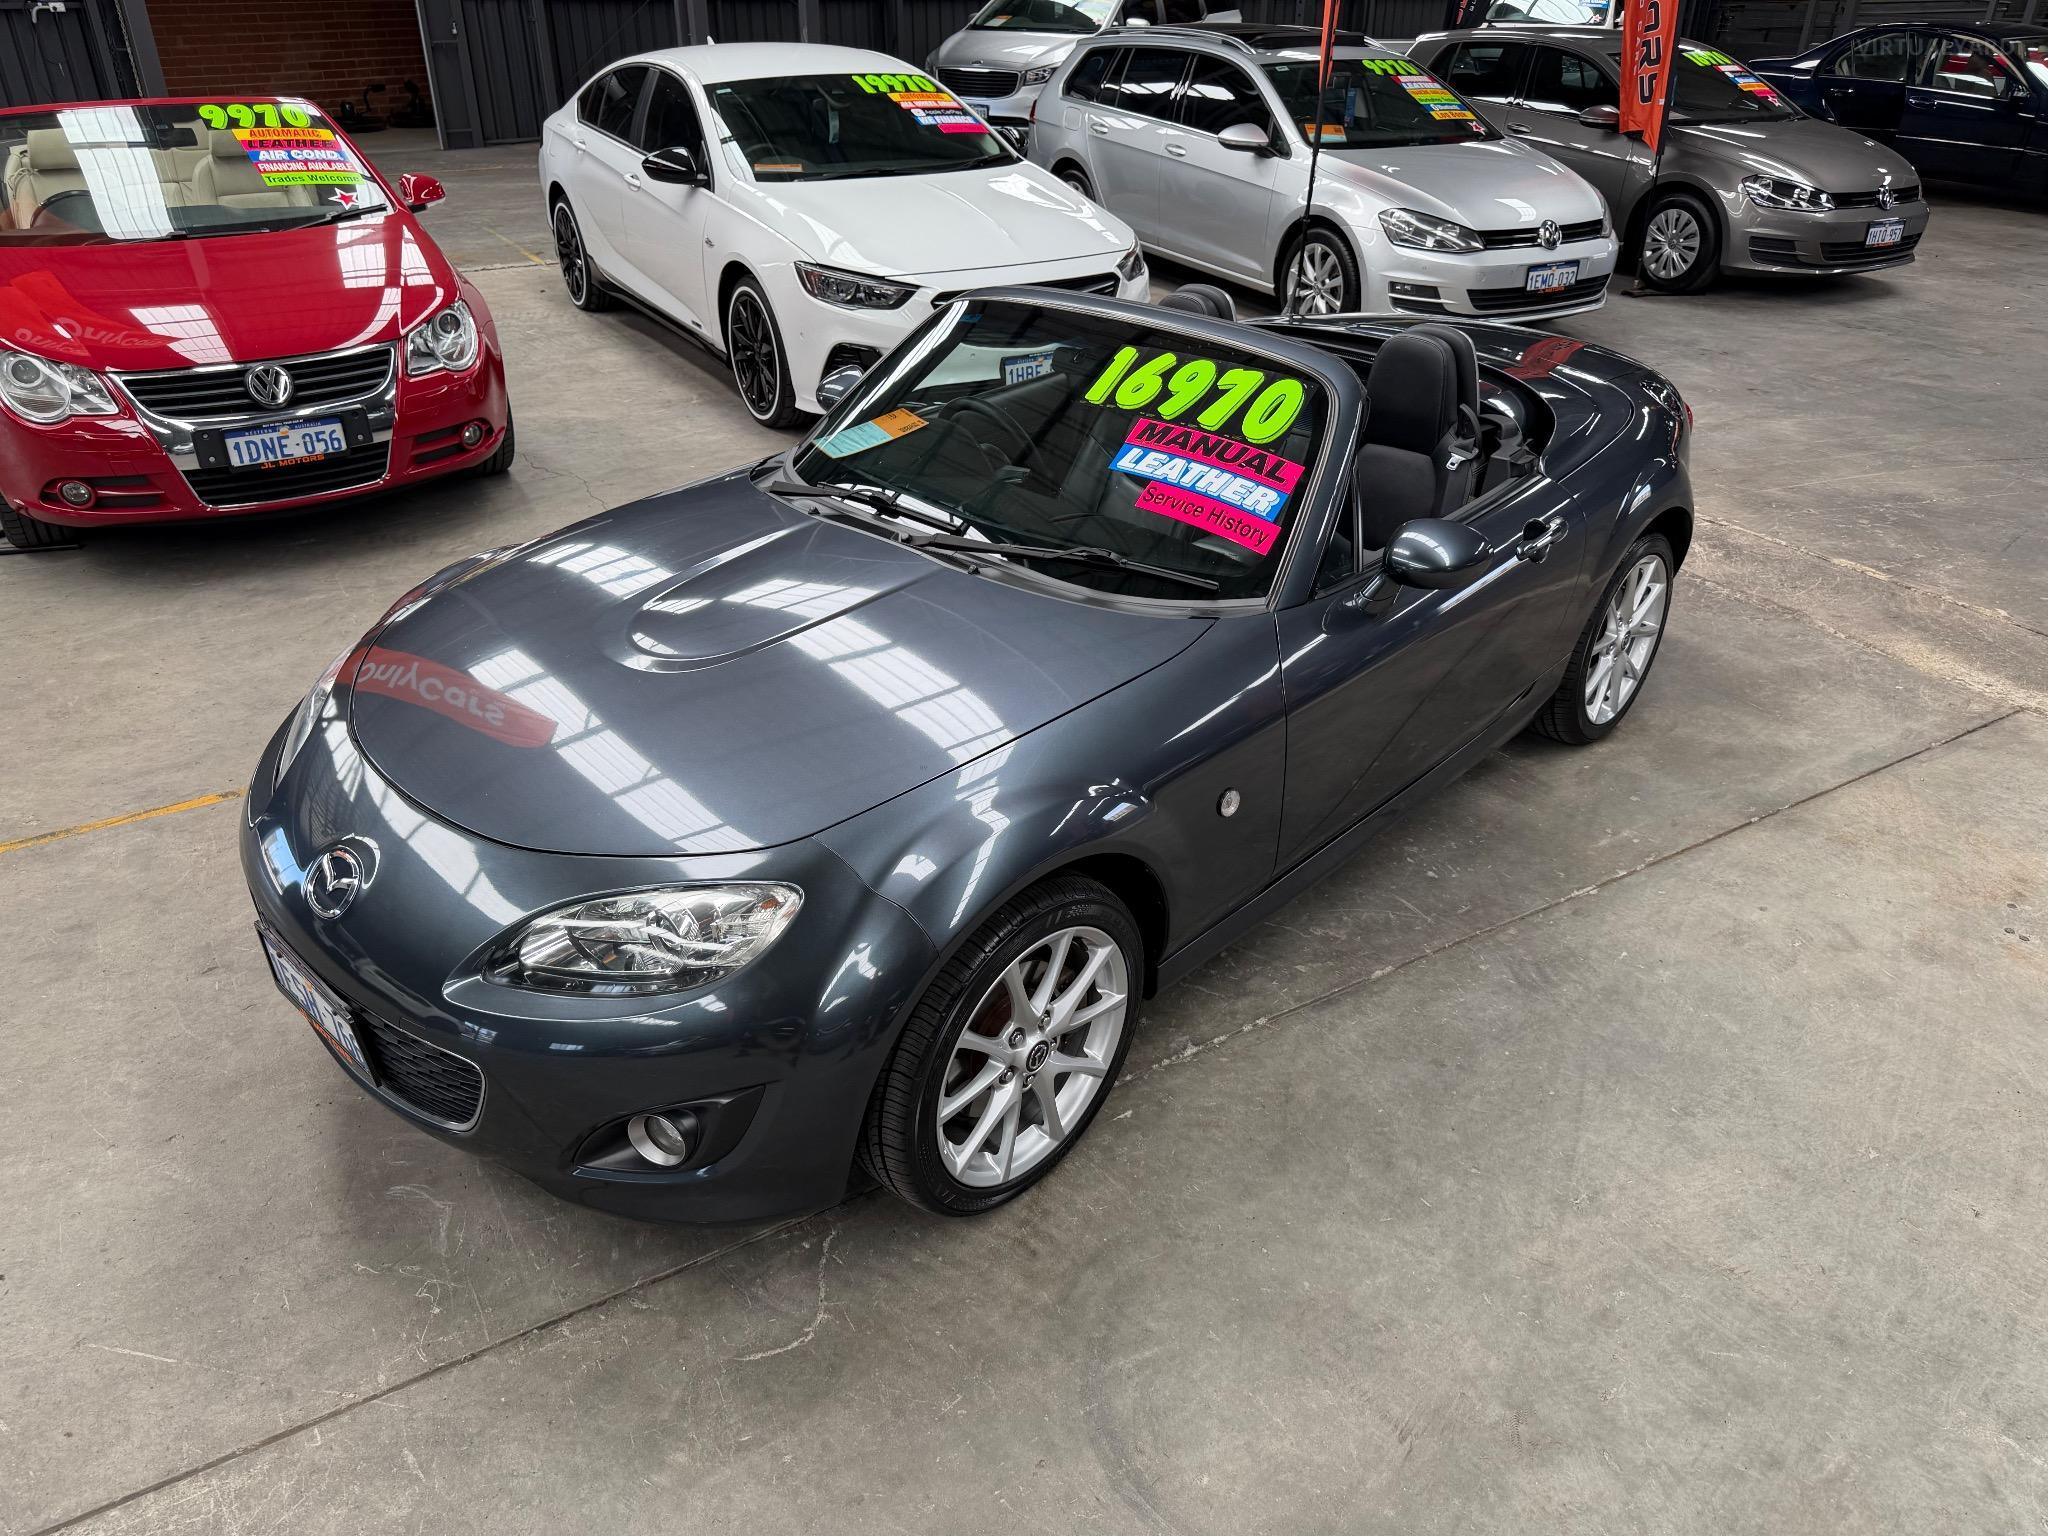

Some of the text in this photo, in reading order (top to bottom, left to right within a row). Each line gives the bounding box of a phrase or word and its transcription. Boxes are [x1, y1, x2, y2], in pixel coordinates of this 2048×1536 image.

[1361, 59, 1420, 76] 9970
[851, 74, 937, 94] 19970
[198, 103, 311, 130] 9970
[250, 130, 321, 139] AUTOMATIC
[247, 139, 335, 149] LEATHER
[258, 150, 343, 161] AIR COND.
[257, 162, 354, 172] FINANCING AVAILABLE
[266, 174, 361, 184] Trades Welcome
[1084, 346, 1305, 444] 16970
[294, 421, 322, 429] AUSTRALIA
[260, 453, 325, 470] JL MOTORS
[1137, 423, 1288, 486] MANUAL
[1116, 447, 1281, 517] LEATHER
[1142, 486, 1270, 548] Service History
